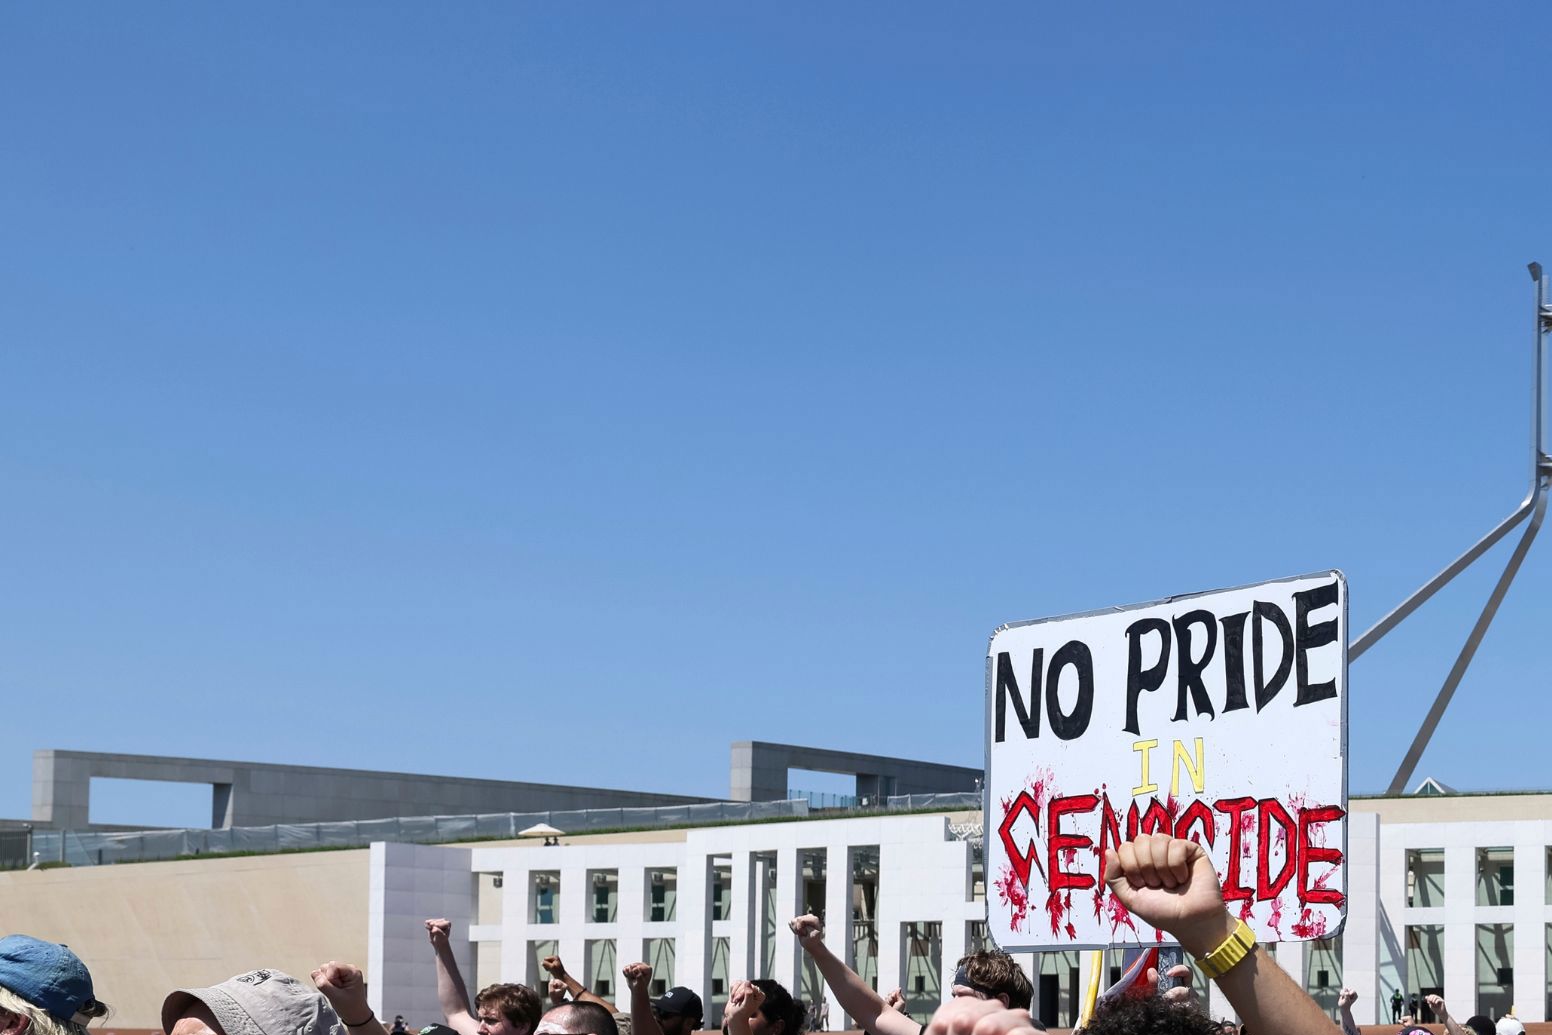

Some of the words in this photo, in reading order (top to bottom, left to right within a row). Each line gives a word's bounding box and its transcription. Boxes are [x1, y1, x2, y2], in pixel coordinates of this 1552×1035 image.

[994, 639, 1095, 743] NO
[1122, 579, 1340, 736] PRIDE
[1131, 736, 1206, 797] IN
